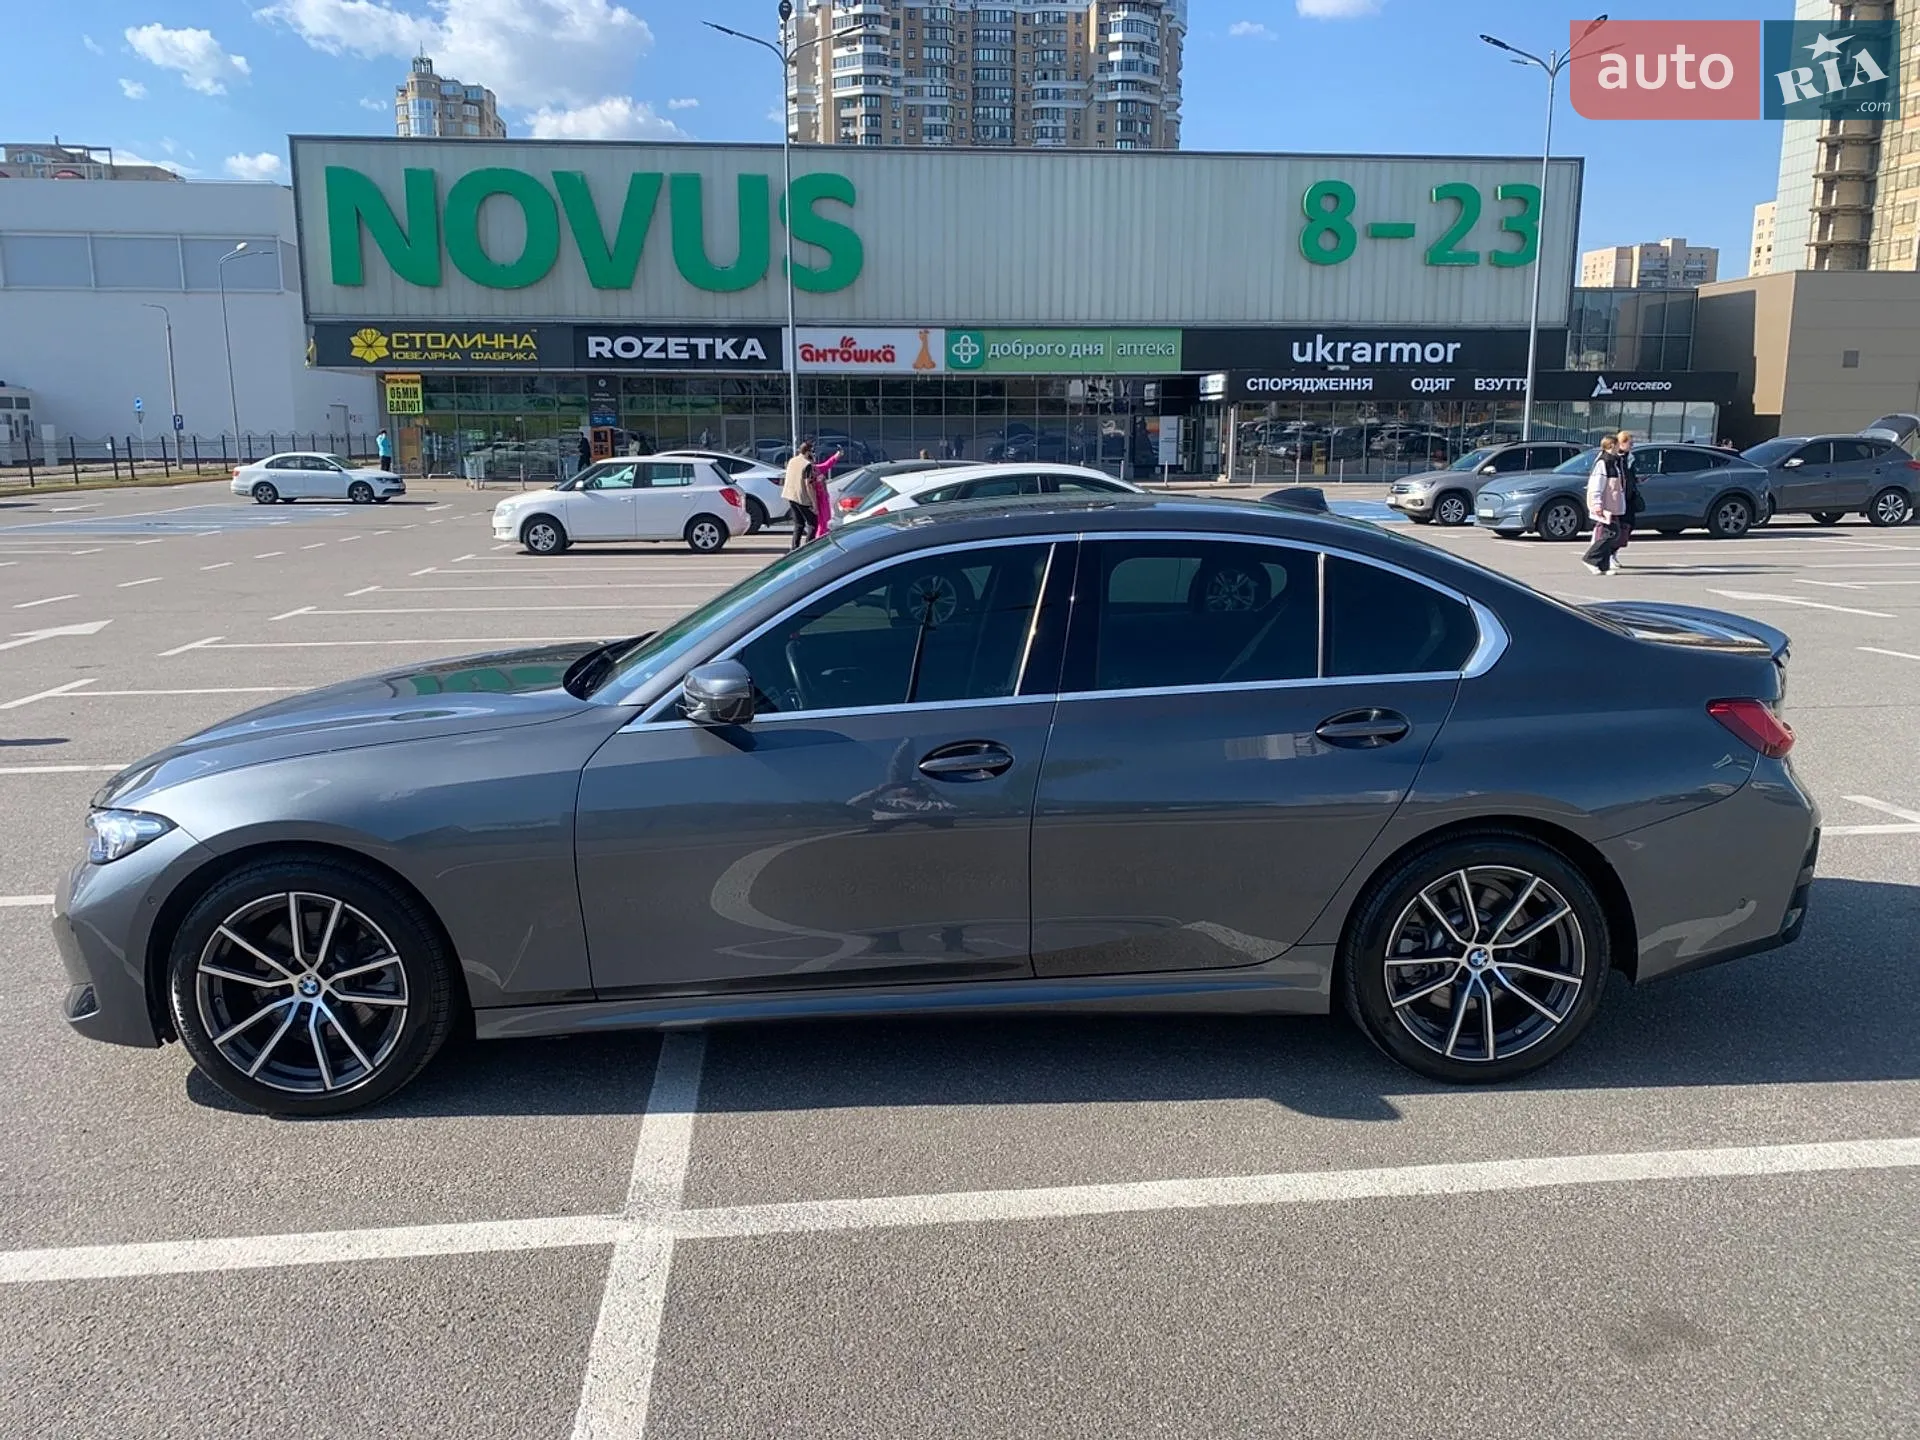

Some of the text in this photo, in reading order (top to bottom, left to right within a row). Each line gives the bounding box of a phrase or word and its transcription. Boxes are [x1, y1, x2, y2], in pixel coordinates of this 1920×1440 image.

[324, 165, 864, 293] NOVUS
[1300, 180, 1543, 267] 8-23
[391, 333, 537, 349] СТОЛИЧНА
[587, 336, 767, 360] ROZETKA
[799, 336, 895, 363] антошка
[987, 339, 1175, 359] доброго дня аптека
[1292, 334, 1461, 363] ukrarmor
[392, 352, 537, 361] ЮВЕЛІРНА ФАБРИКА
[390, 387, 419, 399] ОБМІН
[1246, 377, 1374, 393] СПОРЯДЖЕННЯ
[1411, 378, 1456, 393] ОДЯГ
[1611, 381, 1672, 391] AUTOCREDO
[389, 400, 421, 411] ВАЛЮТ
